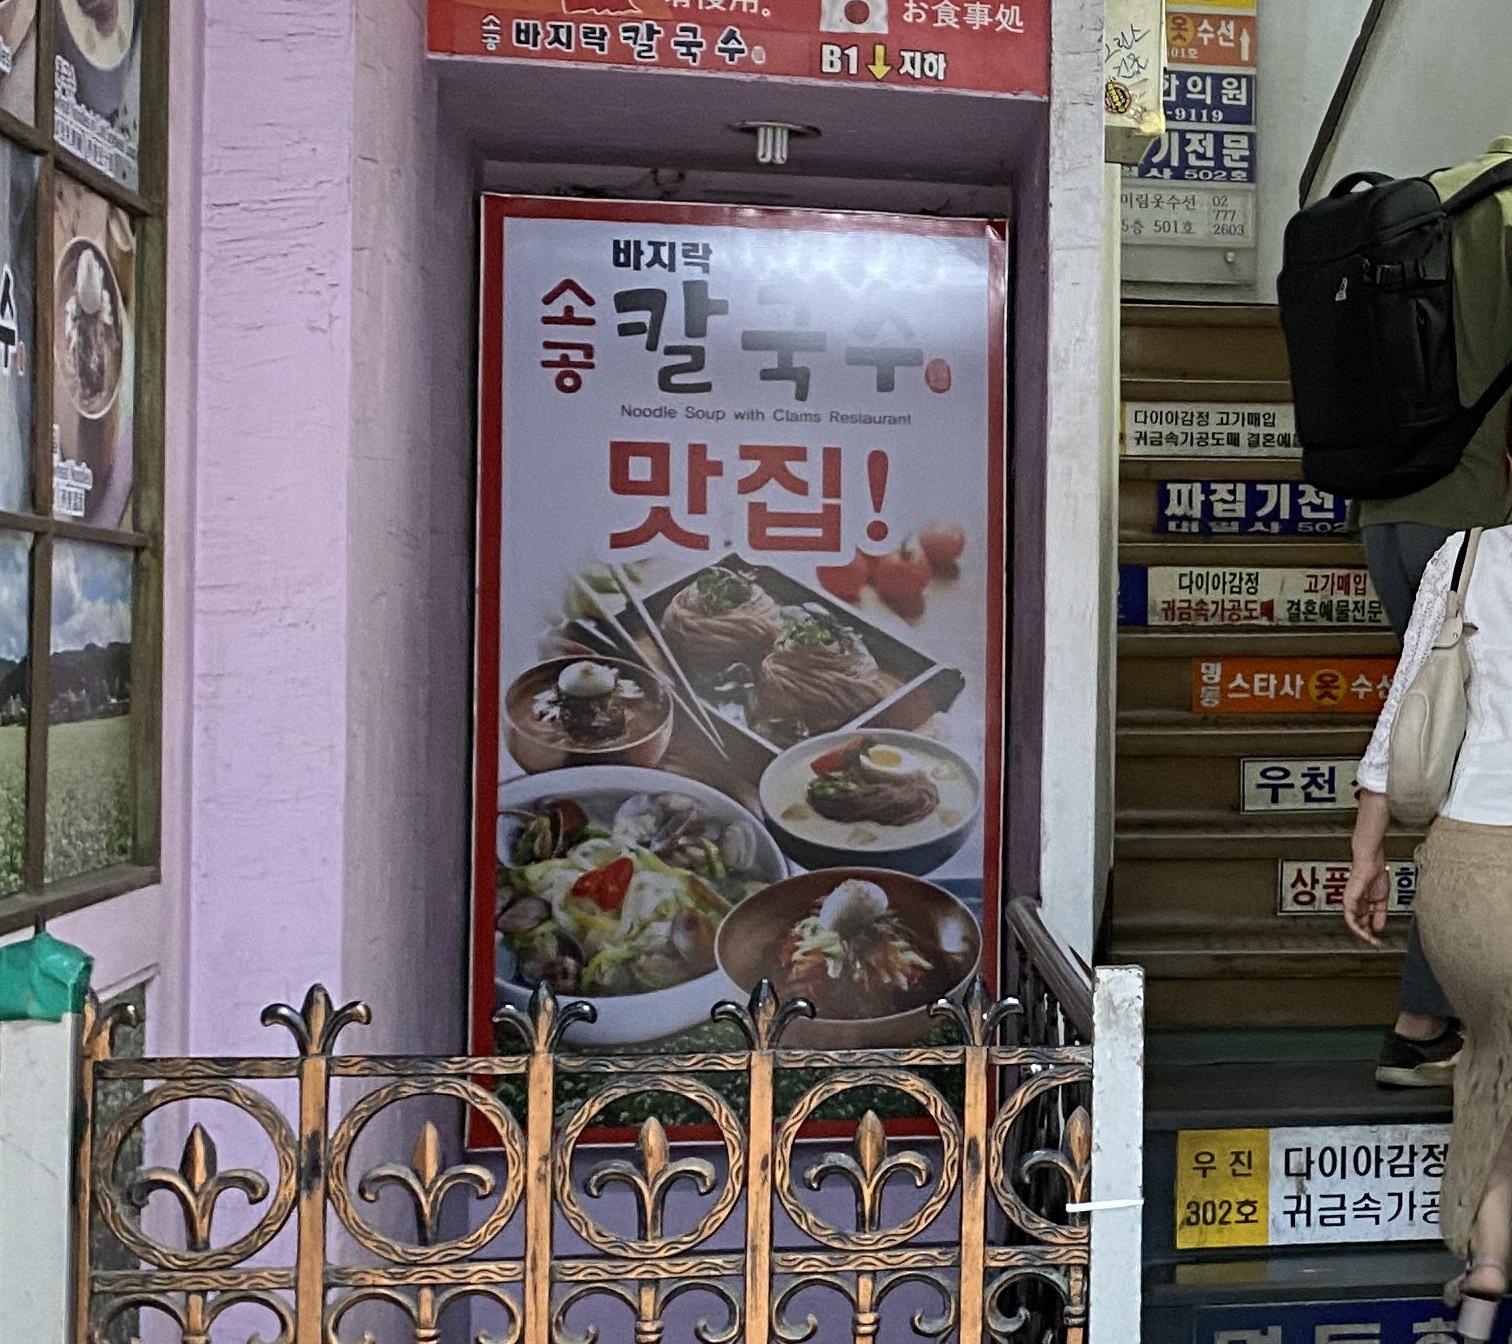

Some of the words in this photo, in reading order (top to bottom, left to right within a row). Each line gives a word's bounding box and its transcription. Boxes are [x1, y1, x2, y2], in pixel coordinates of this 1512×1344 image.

[513, 20, 610, 55] 바지락
[619, 20, 748, 65] 칼국수
[820, 43, 859, 75] B1
[899, 48, 948, 82] 지하
[1212, 195, 1229, 207] 02
[611, 238, 713, 274] 바지락
[540, 277, 597, 395] 소공
[612, 279, 925, 403] 칼국수
[620, 404, 678, 420] Noodle
[685, 406, 727, 423] Soup
[734, 407, 766, 422] with
[772, 408, 822, 425] Clams
[829, 410, 913, 426] Restaurant
[1133, 408, 1211, 427] 다이아감정
[608, 439, 890, 553] 맛집!
[1164, 482, 1350, 521] 짜집기전
[1178, 570, 1260, 596] 다이아감정
[1185, 1198, 1260, 1228] 302호
